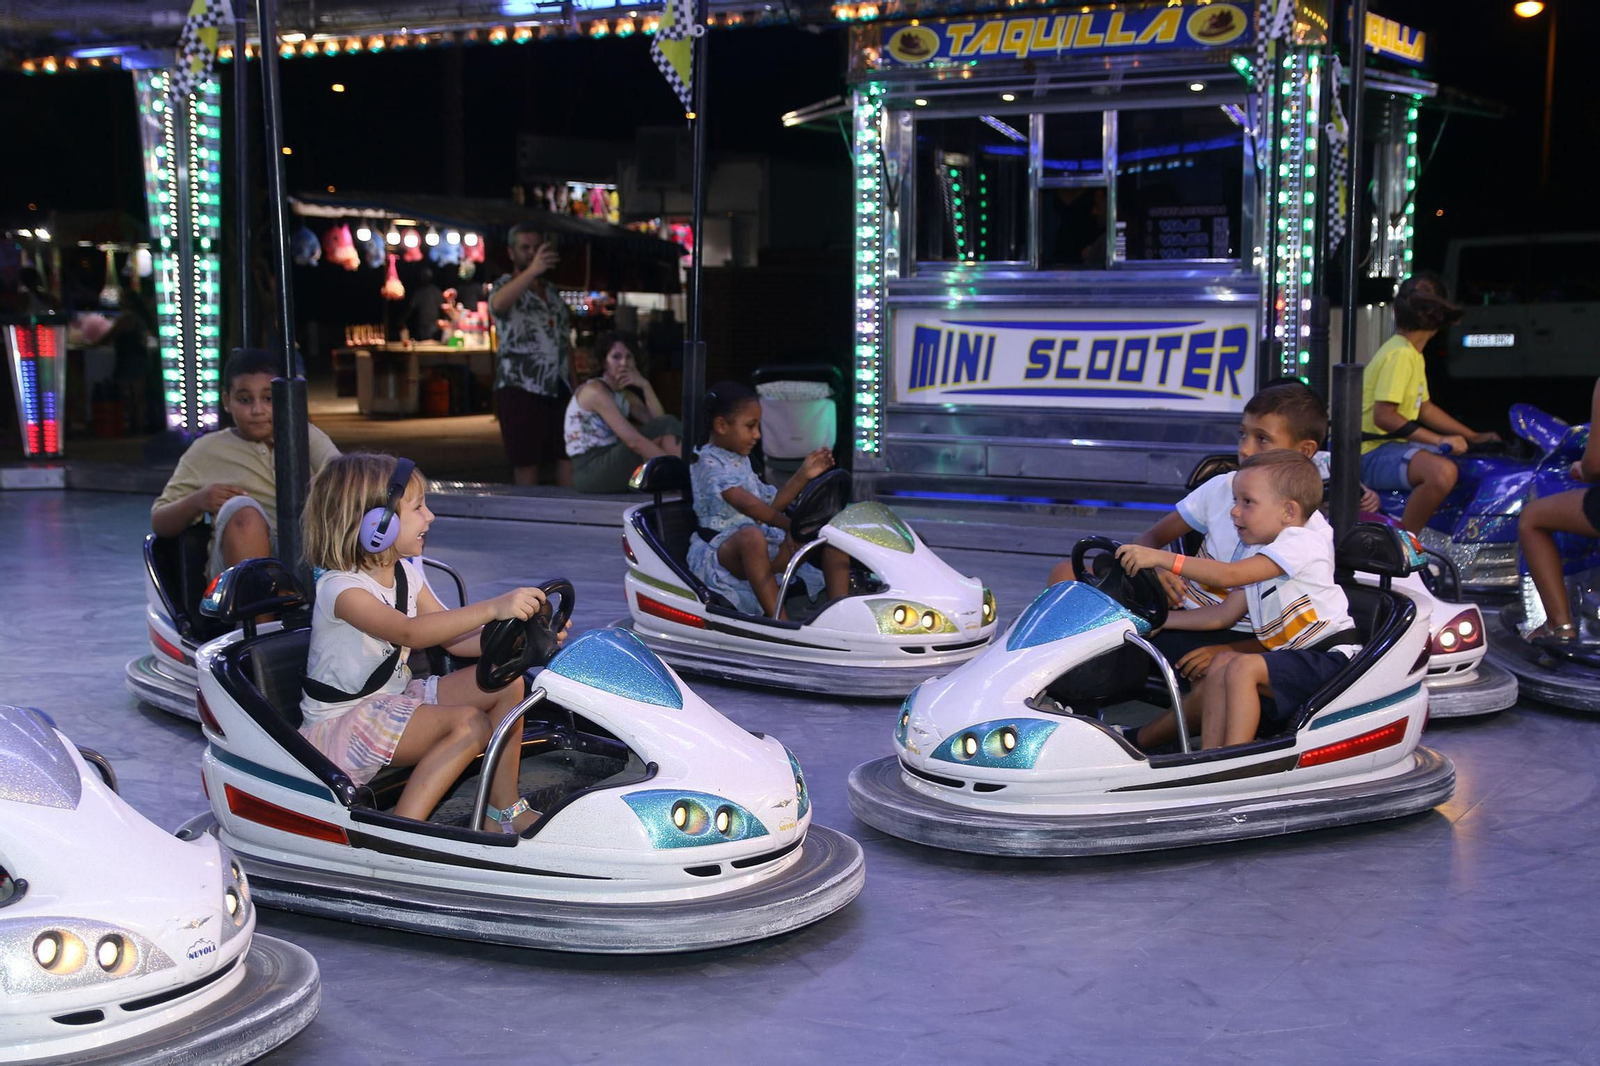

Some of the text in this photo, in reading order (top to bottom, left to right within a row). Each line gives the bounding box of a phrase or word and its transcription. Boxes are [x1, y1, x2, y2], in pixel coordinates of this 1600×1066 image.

[946, 7, 1184, 59] TAQUILLA
[907, 323, 1249, 398] MINI SCOOTER
[1466, 518, 1479, 539] 5
[188, 944, 216, 960] NUVOLA
